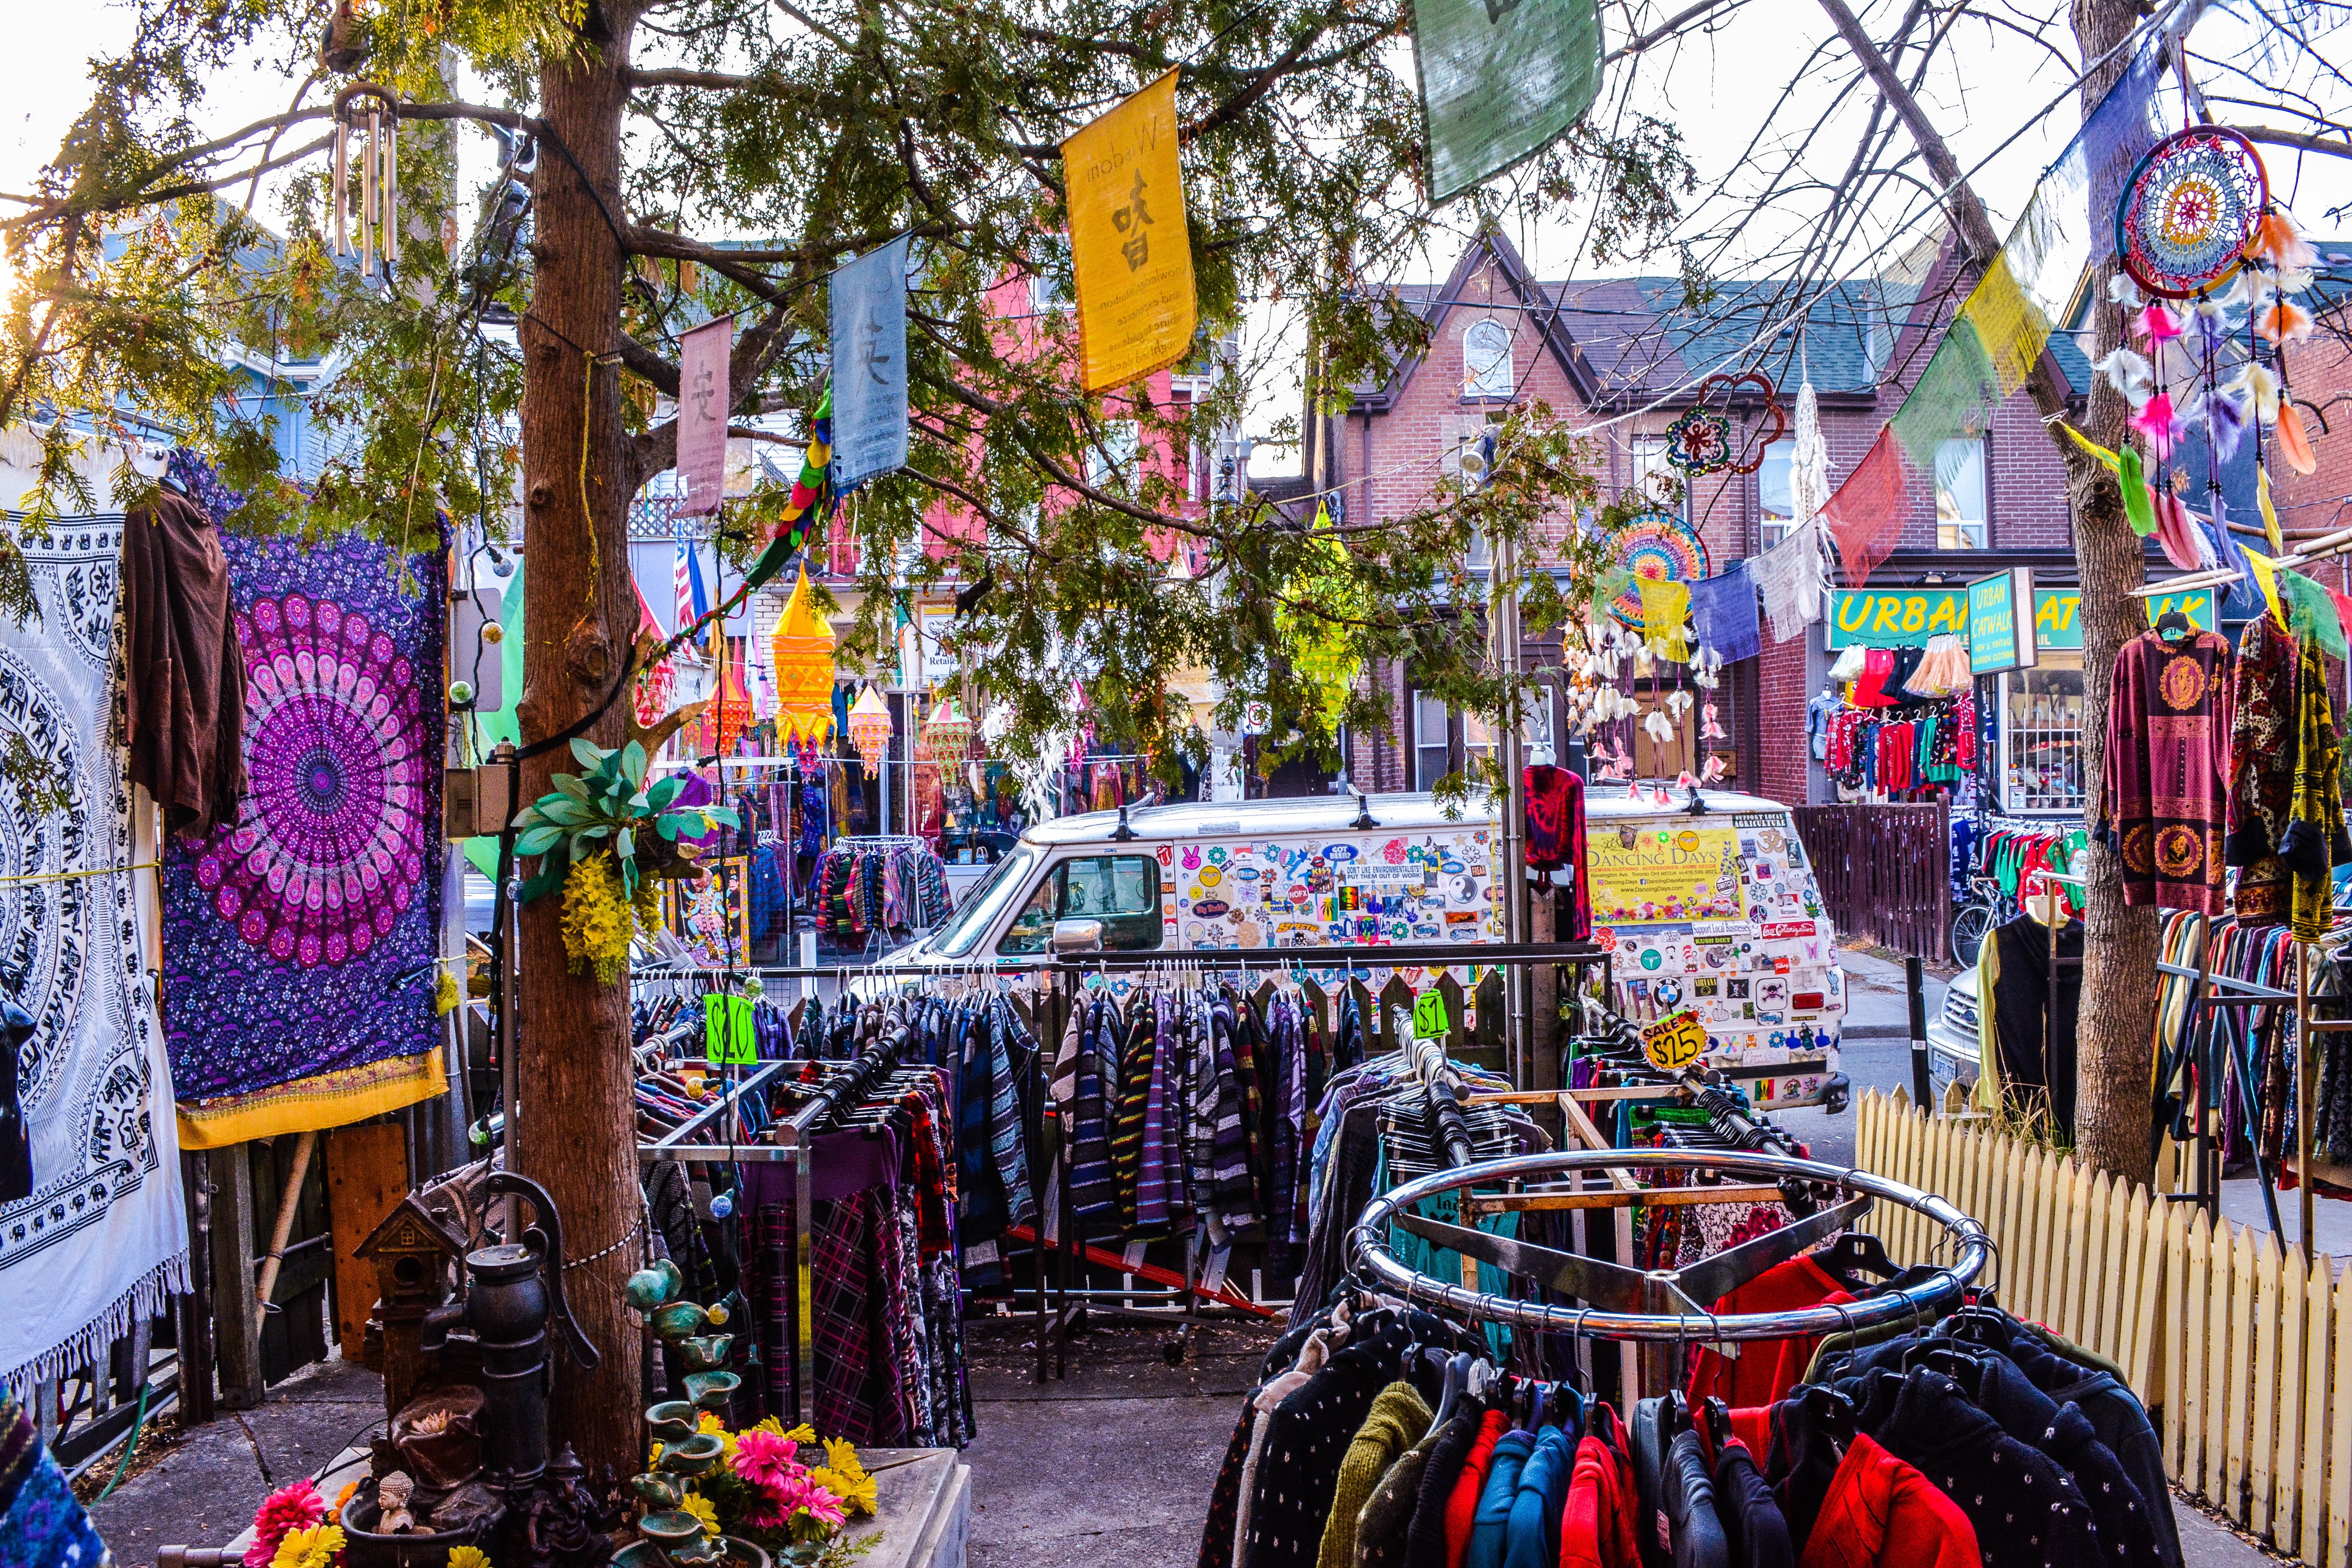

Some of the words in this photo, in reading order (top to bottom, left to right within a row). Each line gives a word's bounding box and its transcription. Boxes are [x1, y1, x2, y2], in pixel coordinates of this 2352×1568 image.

[1976, 583, 2005, 610] URBAN
[1972, 610, 2013, 638] CATWALK
[1992, 637, 2011, 648] VINTAGE
[1735, 819, 1786, 828] AGRICULTURE
[1671, 848, 1717, 864] DAYS
[1373, 865, 1421, 873] ENVIRONMENTALISTS?
[1472, 866, 1486, 876] FREAK
[1161, 883, 1175, 893] FREAK
[1289, 890, 1308, 898] NOFX
[1693, 923, 1711, 934] Support
[1712, 922, 1725, 933] Local
[1726, 921, 1750, 932] Businesses
[1695, 978, 1717, 987] NIRVANA
[1643, 1017, 1680, 1040] SALE
[1653, 1025, 1698, 1066] $25
